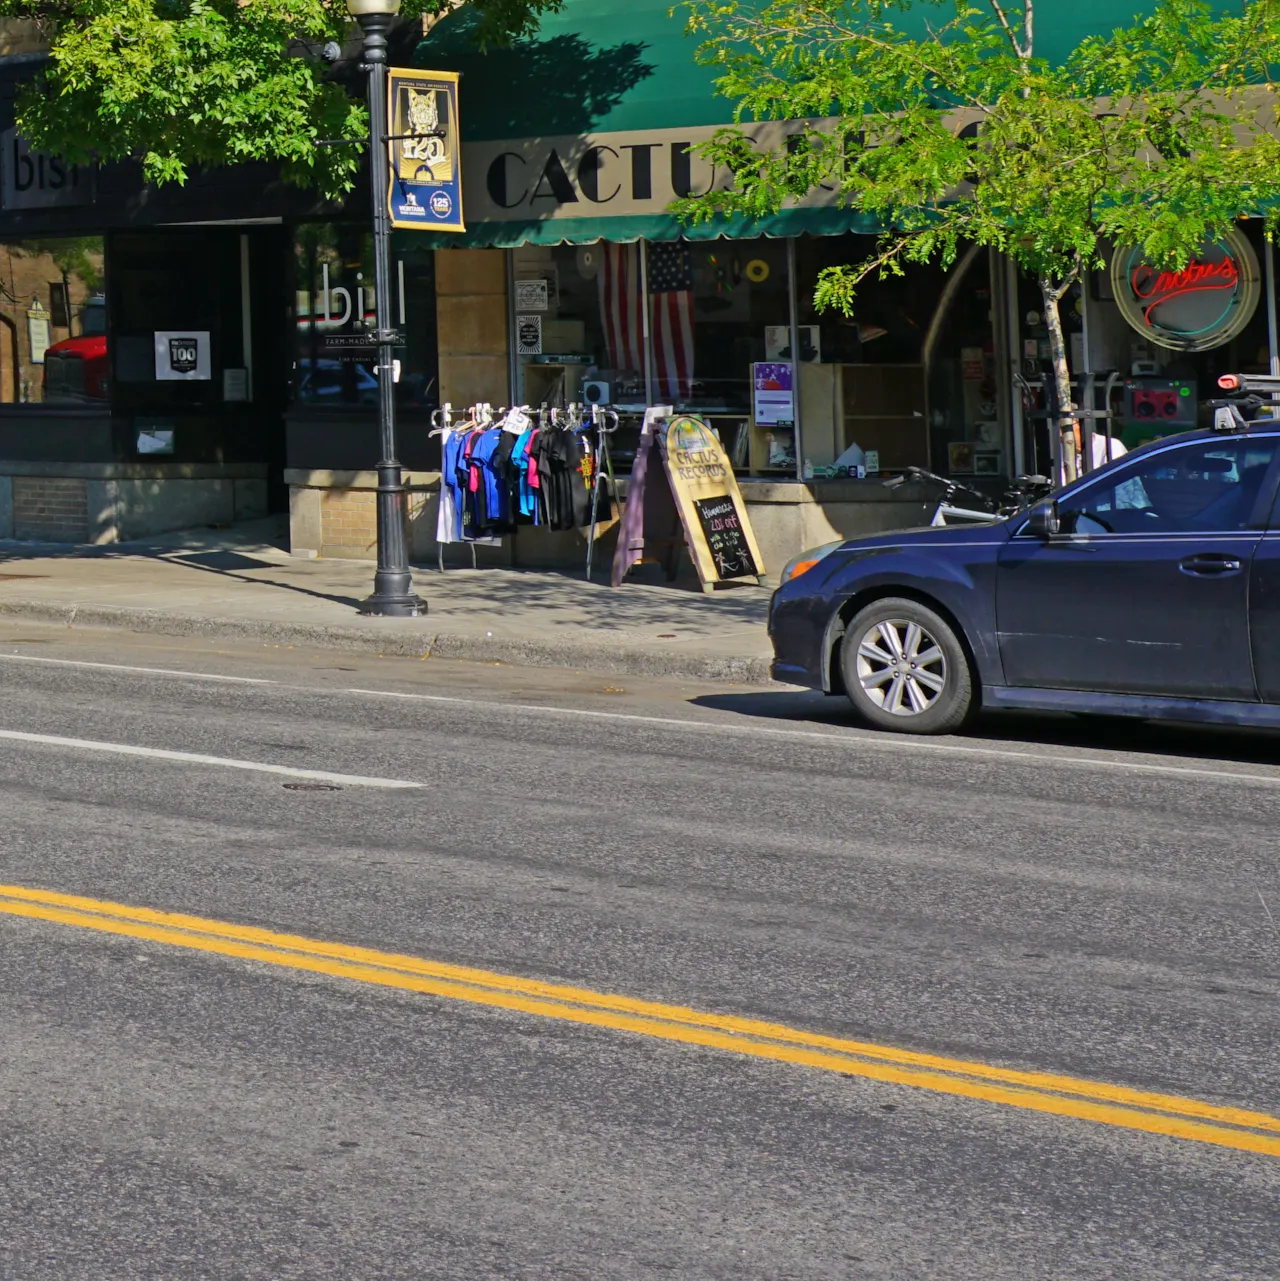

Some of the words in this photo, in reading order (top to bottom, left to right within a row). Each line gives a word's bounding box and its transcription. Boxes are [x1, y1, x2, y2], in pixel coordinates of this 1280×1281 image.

[432, 197, 449, 208] 125
[171, 348, 196, 361] 100
[676, 449, 719, 465] CACTUS
[678, 463, 728, 481] RECORDS
